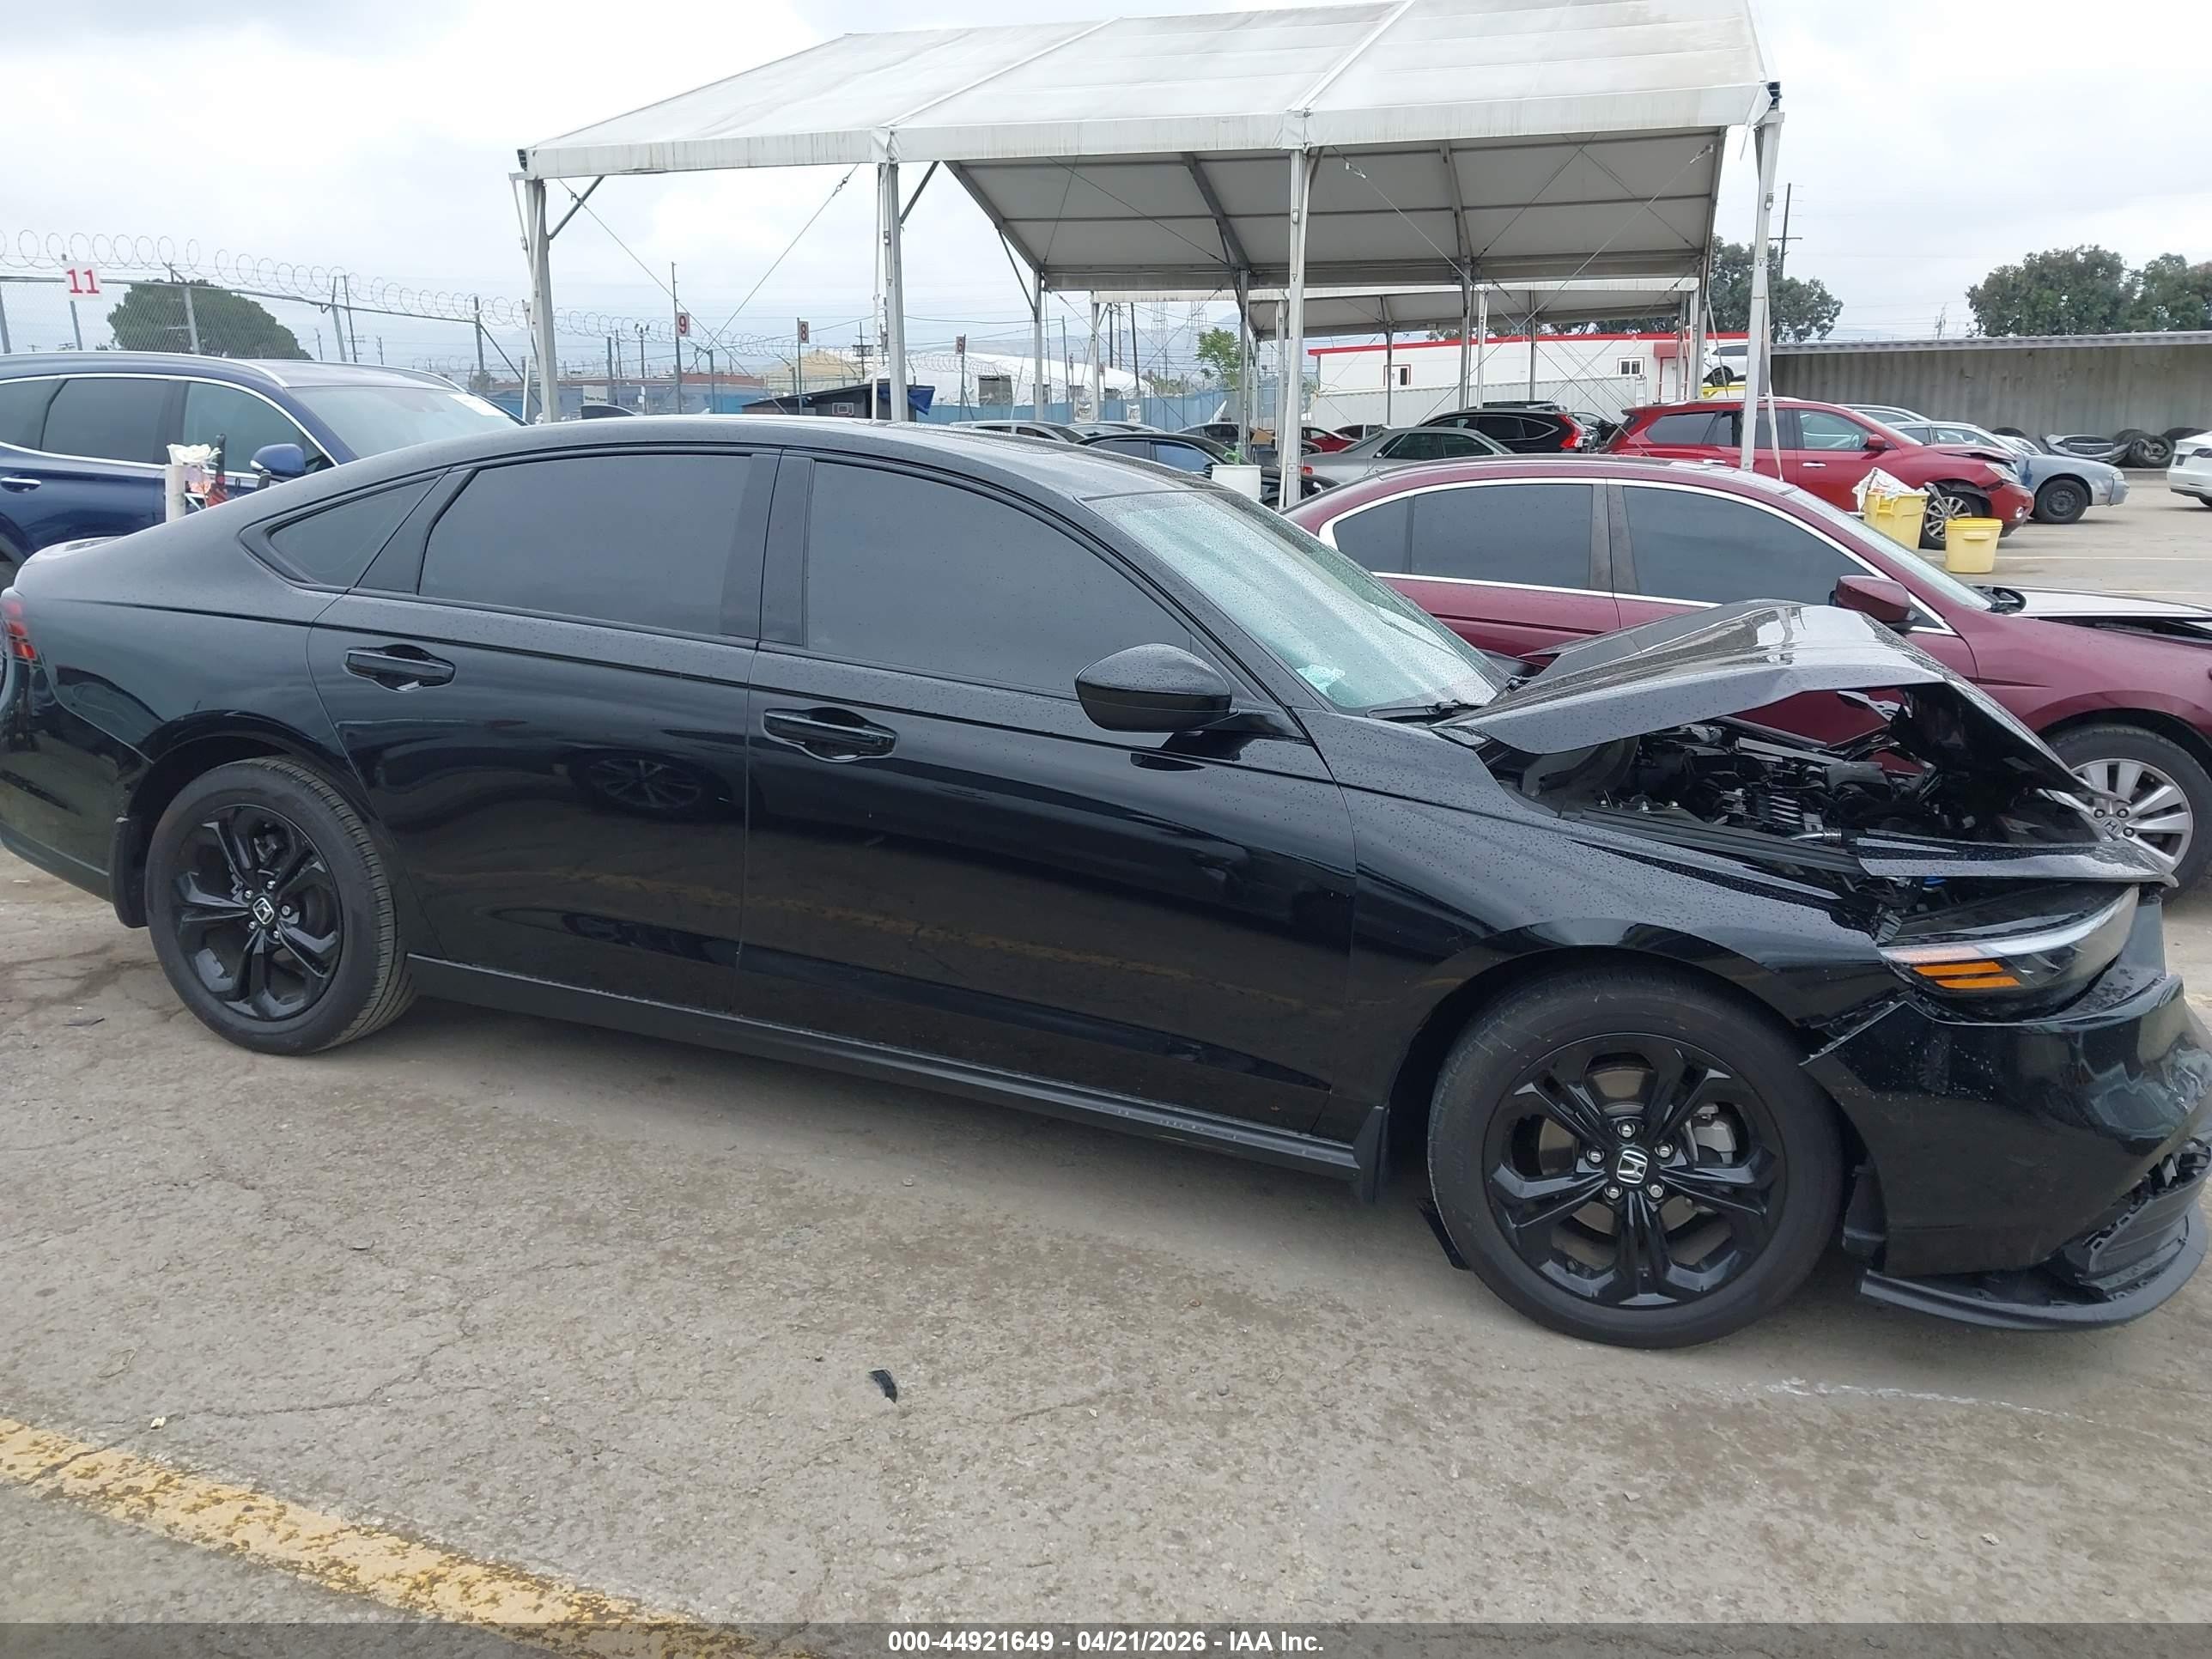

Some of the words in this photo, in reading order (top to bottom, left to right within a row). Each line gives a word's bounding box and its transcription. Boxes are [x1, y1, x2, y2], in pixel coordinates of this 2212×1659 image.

[66, 268, 100, 295] 11
[678, 315, 687, 334] 9
[800, 324, 807, 341] 8
[957, 338, 963, 352] 6
